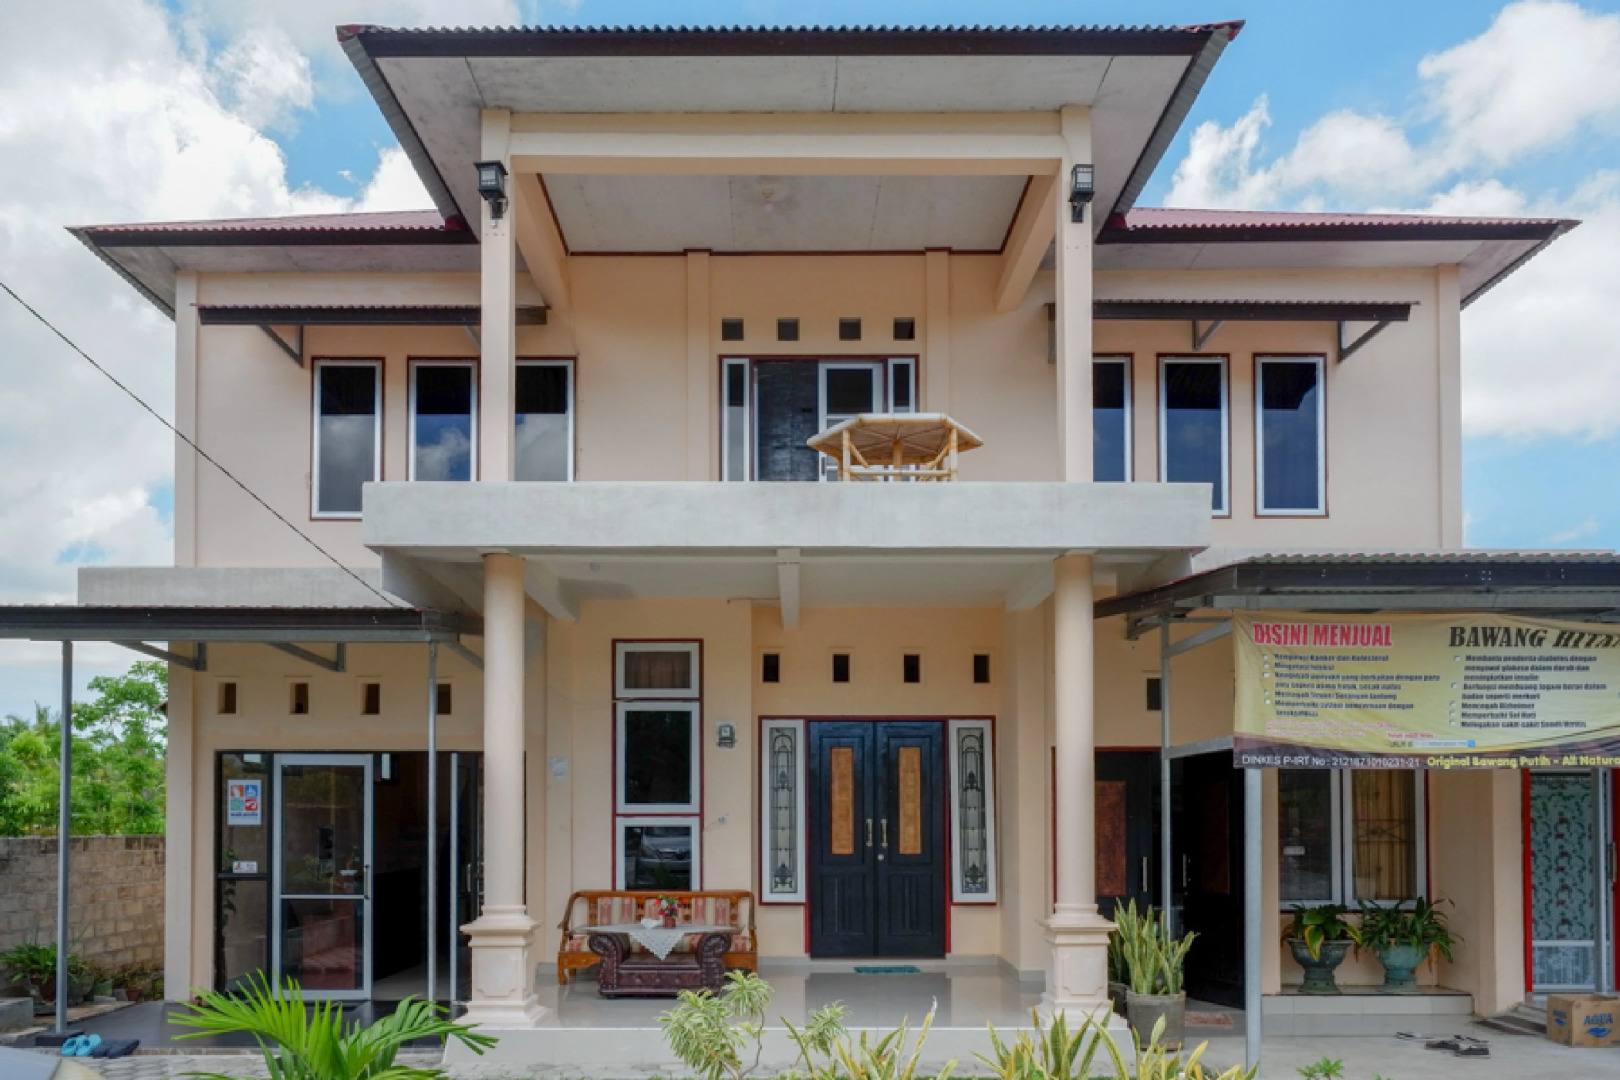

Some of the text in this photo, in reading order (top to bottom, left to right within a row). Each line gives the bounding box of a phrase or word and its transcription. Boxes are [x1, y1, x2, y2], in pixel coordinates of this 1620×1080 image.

[1253, 624, 1392, 647] DISINI MENJUAL
[1449, 626, 1548, 648] BAWANG
[1242, 755, 1281, 765] DINKES
[1427, 755, 1470, 769] Original
[1520, 755, 1550, 766] Putih
